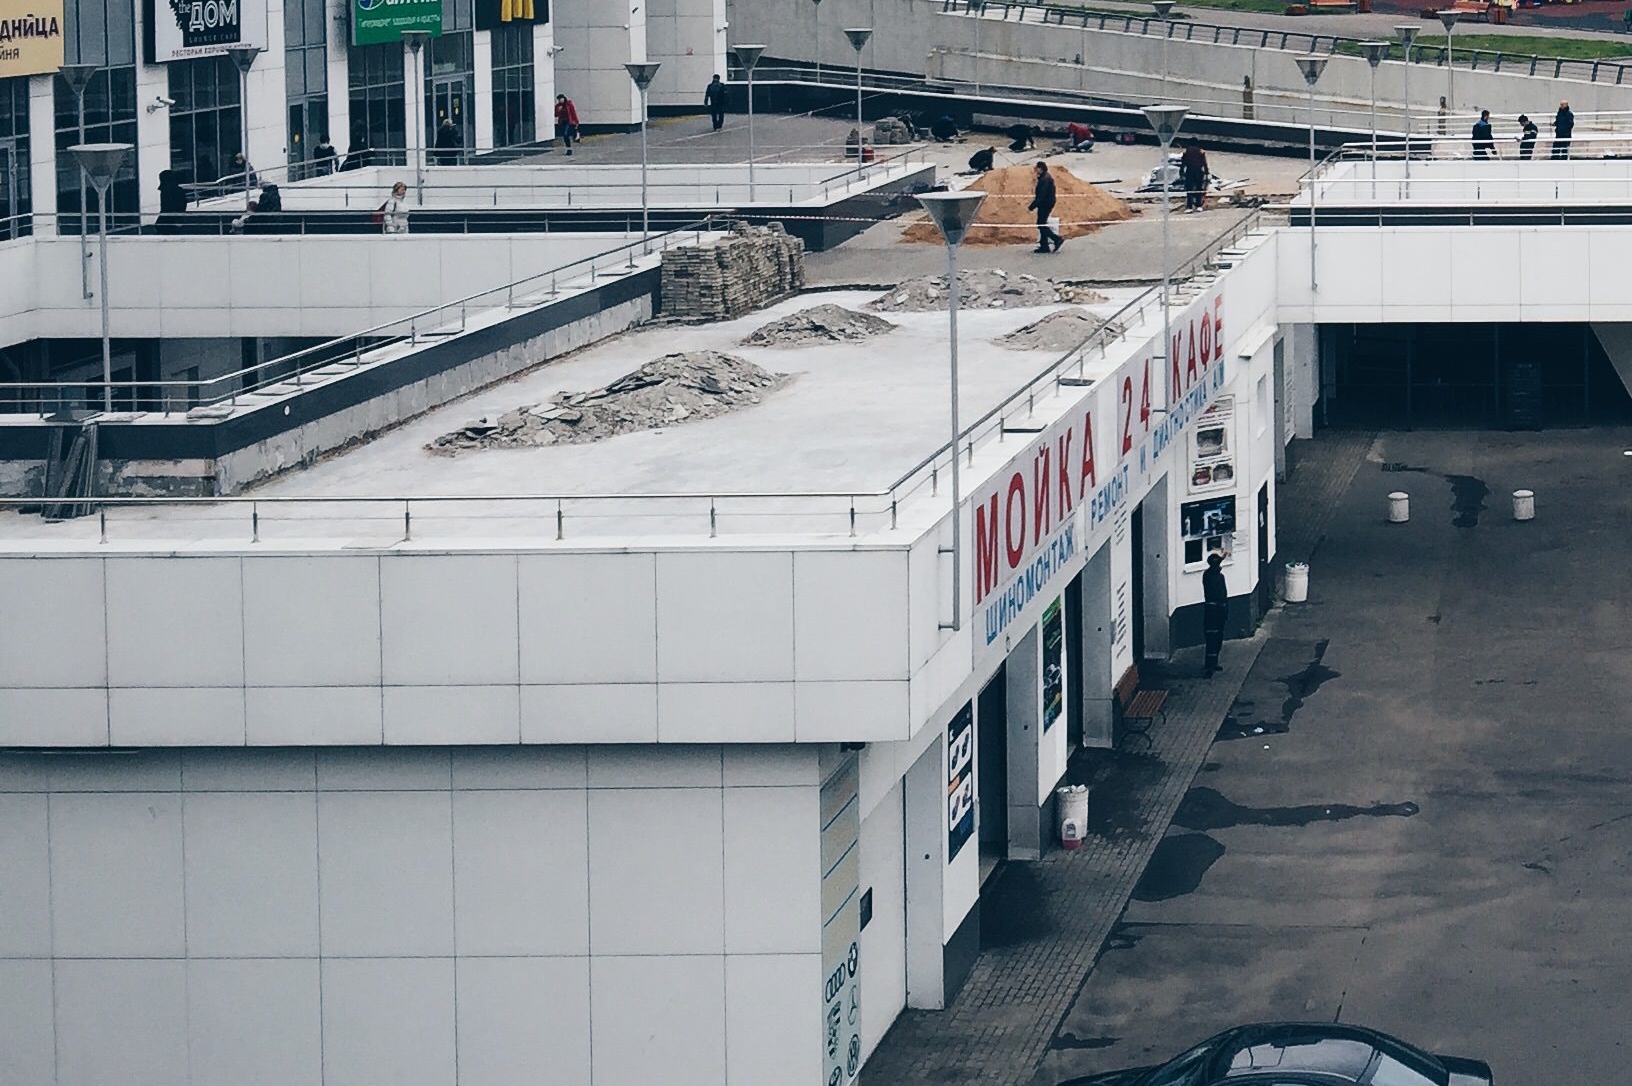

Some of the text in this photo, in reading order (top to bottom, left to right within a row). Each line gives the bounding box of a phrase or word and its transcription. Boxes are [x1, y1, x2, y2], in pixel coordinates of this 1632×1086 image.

[179, 0, 237, 32] the ДОМ
[976, 411, 1096, 606] МОЙКА
[1122, 358, 1151, 457] 24
[1172, 294, 1224, 404] КАФЕ
[985, 523, 1075, 645] ШИНОМОНТАЖ
[1091, 464, 1129, 531] РЕМОНТ
[1139, 444, 1147, 475] И
